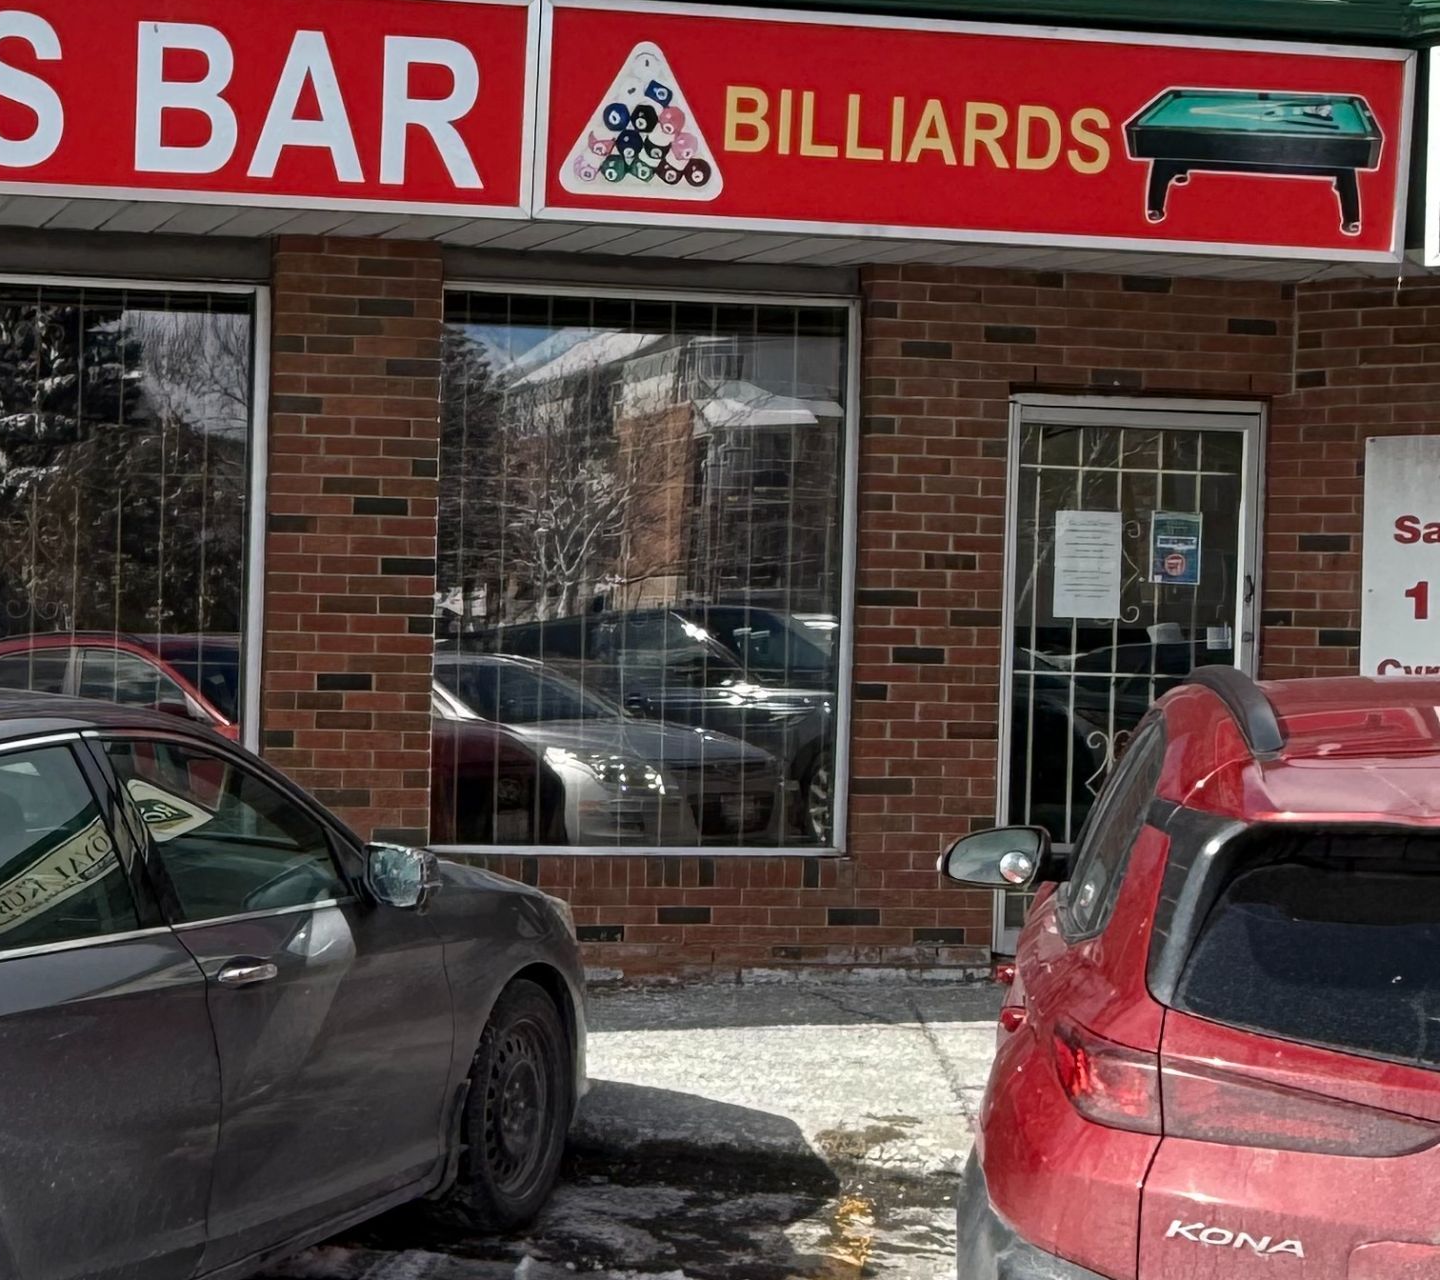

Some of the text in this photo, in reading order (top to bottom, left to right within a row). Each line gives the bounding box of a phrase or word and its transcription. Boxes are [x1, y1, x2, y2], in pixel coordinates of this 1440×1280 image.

[133, 20, 484, 190] BAR
[724, 85, 1111, 174] BILLIARDS
[1164, 1219, 1305, 1258] KONA
